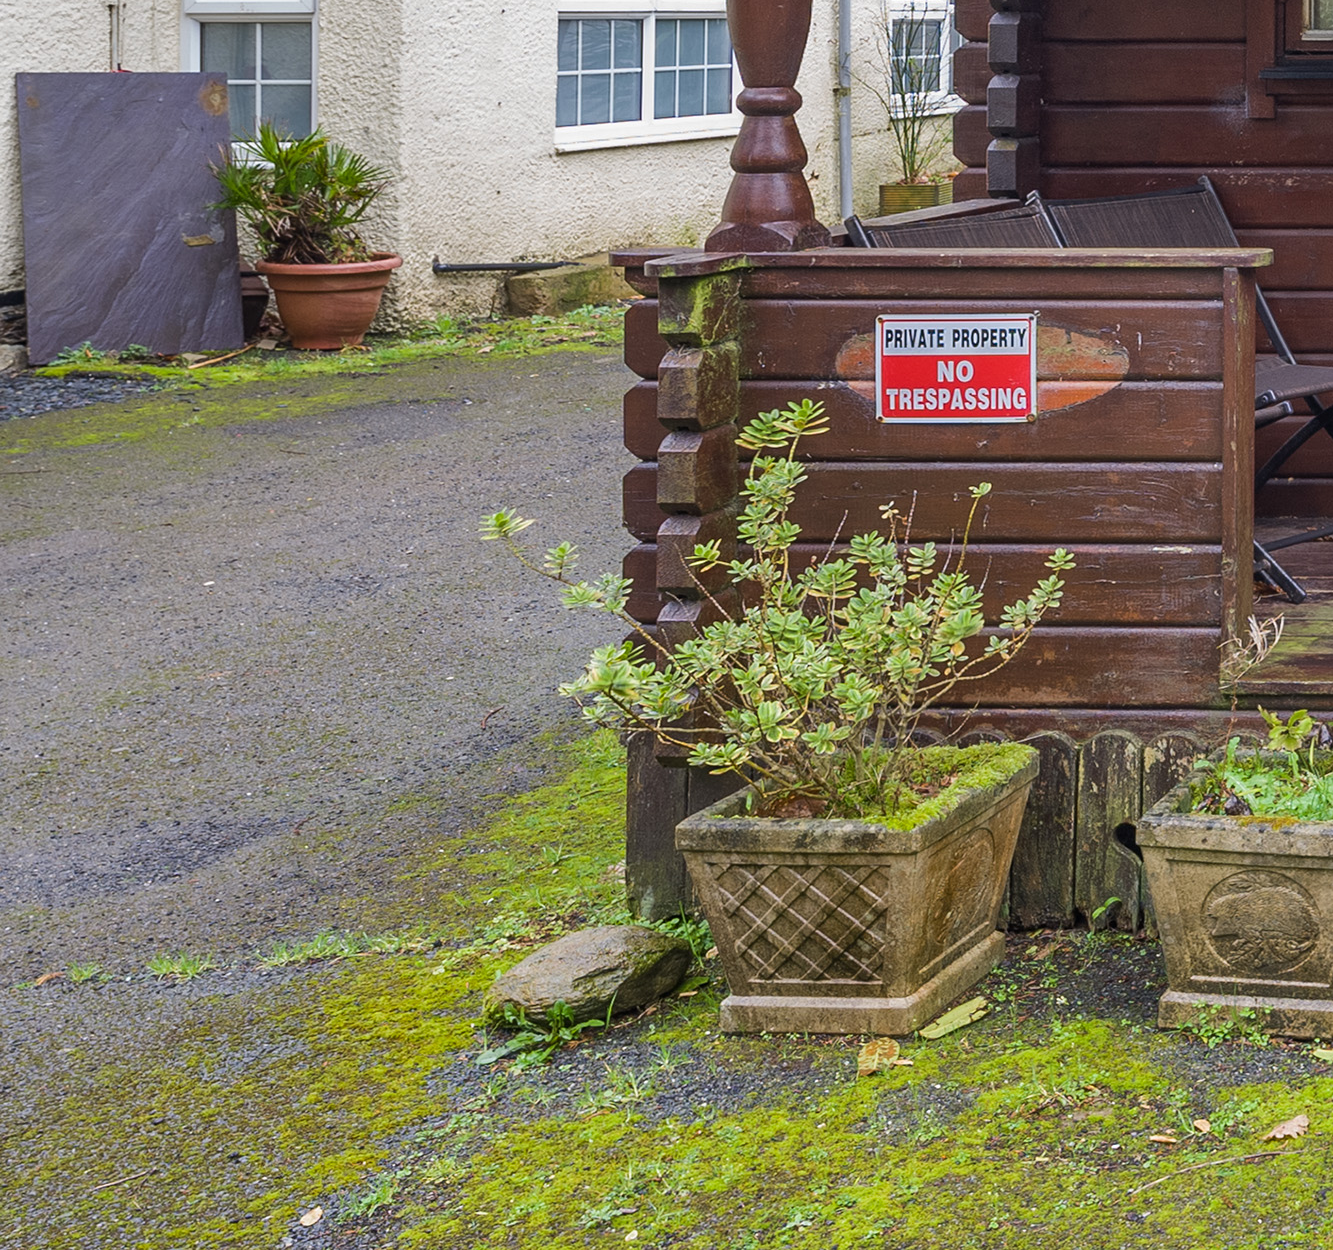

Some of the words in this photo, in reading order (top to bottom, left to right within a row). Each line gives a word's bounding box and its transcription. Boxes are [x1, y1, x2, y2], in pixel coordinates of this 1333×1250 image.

[885, 329, 945, 348] PRIVATE
[952, 328, 1027, 348] PROPERTY
[936, 360, 974, 383] NO
[886, 387, 1027, 411] TRESPASSING
